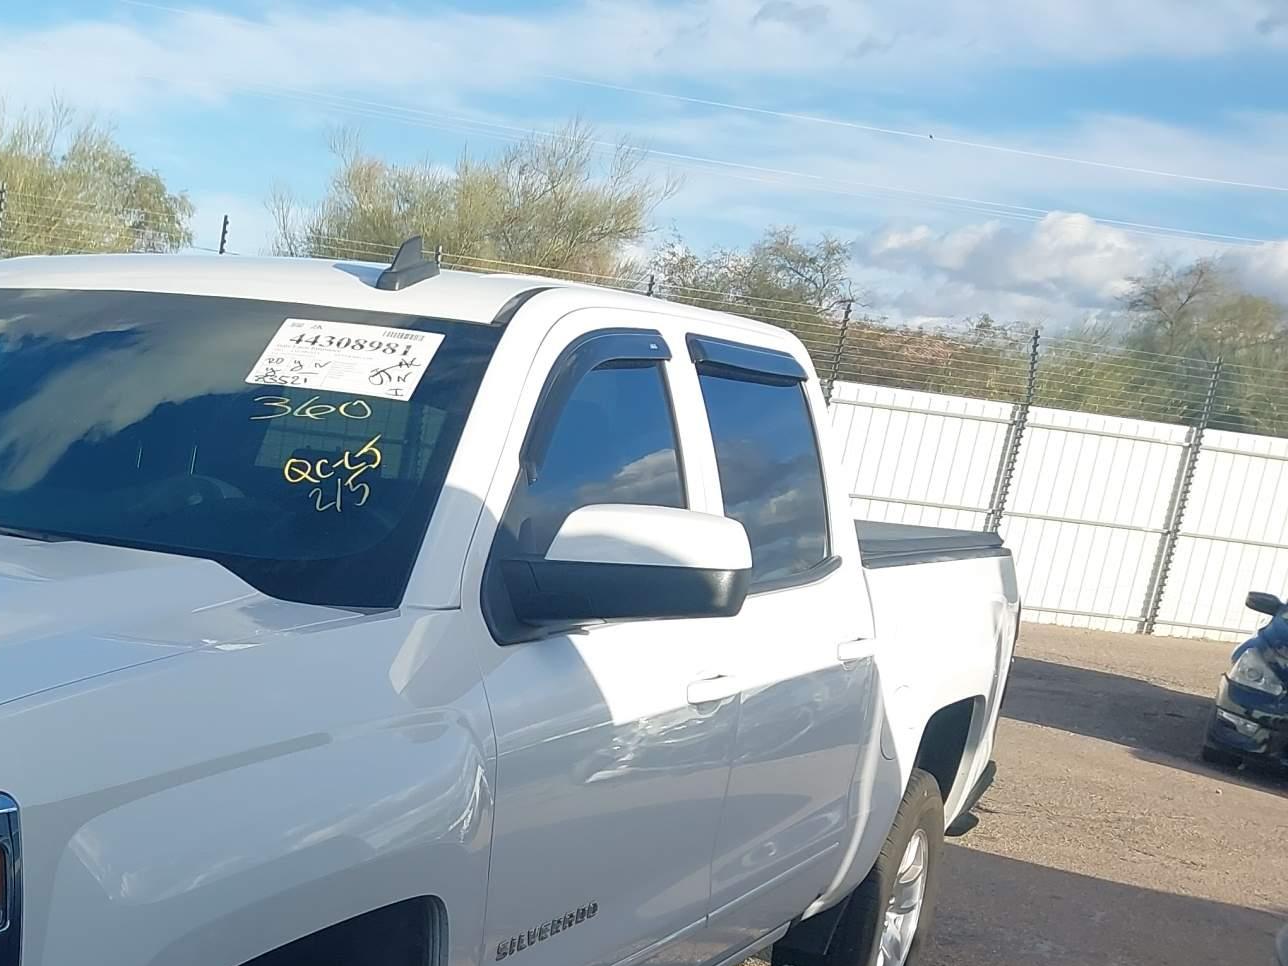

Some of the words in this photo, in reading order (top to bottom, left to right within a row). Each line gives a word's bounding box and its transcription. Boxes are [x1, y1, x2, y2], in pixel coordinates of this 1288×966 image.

[288, 333, 413, 356] 44308981
[249, 395, 372, 420] 360
[495, 901, 599, 961] SILVERADO
